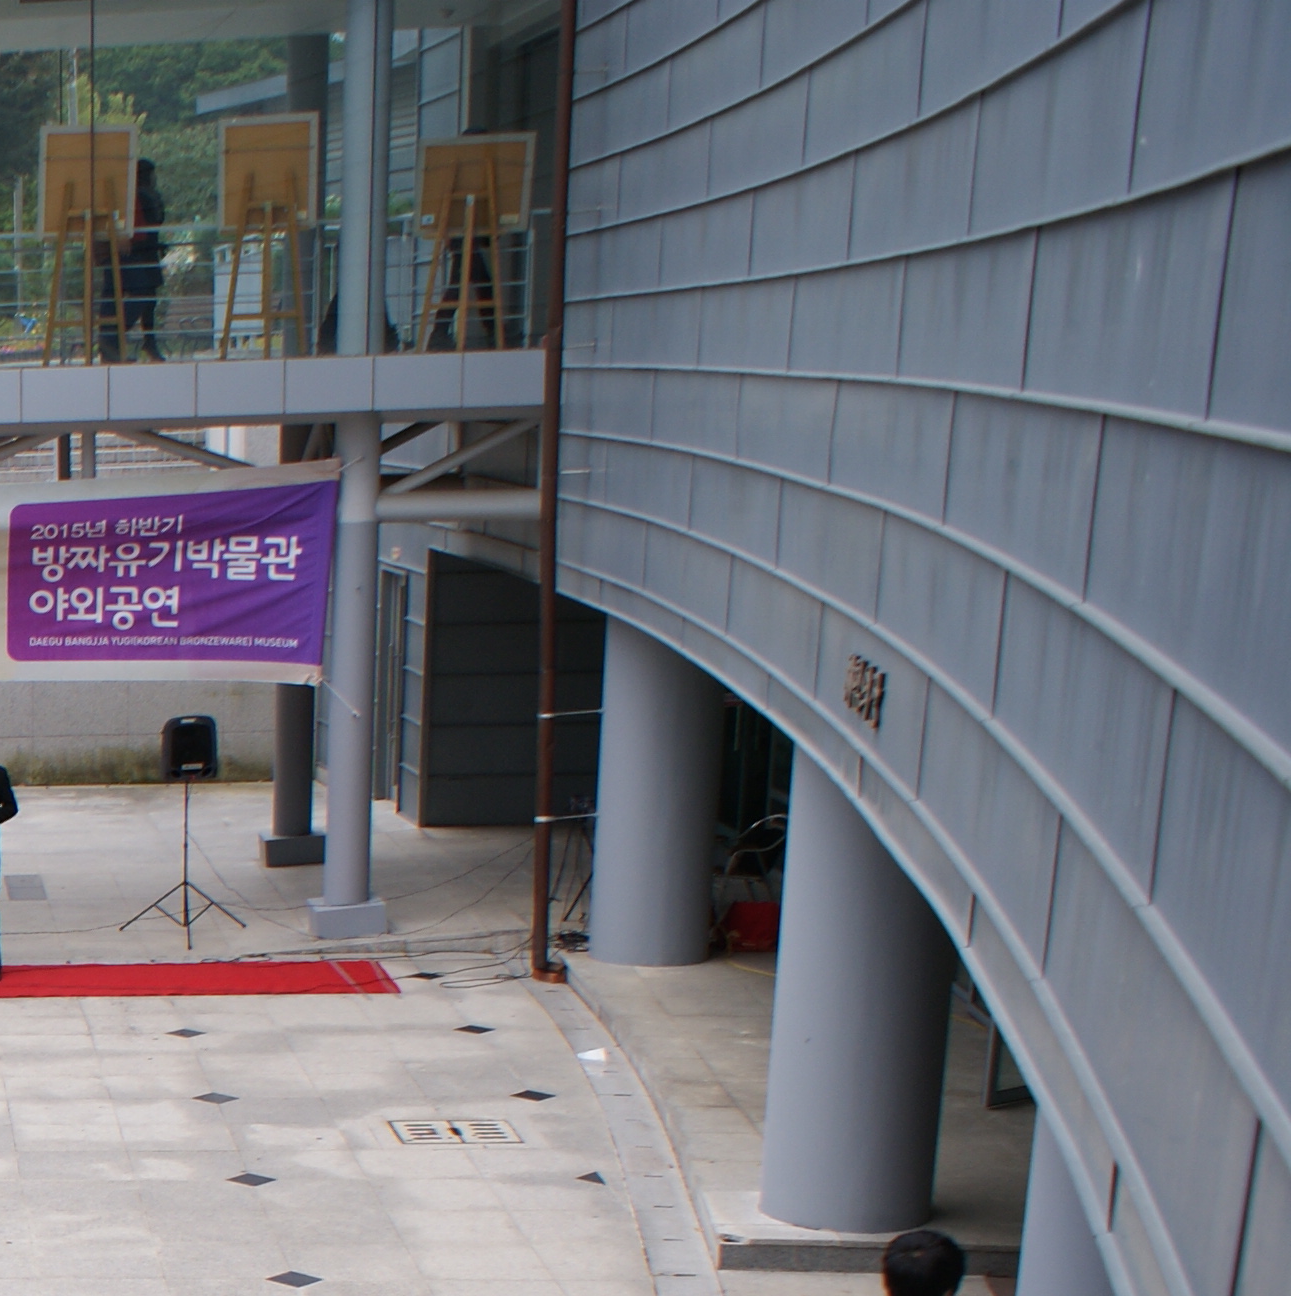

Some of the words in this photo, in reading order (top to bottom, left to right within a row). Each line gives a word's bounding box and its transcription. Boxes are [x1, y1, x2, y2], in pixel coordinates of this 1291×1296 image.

[29, 519, 107, 540] 2015년
[113, 514, 184, 538] 하반기
[30, 535, 303, 583] 방짜유기박물관
[28, 585, 181, 631] 야외공연
[29, 635, 63, 647] DAEGU
[64, 635, 110, 647] BANGJJA
[254, 636, 299, 649] MUSEUM
